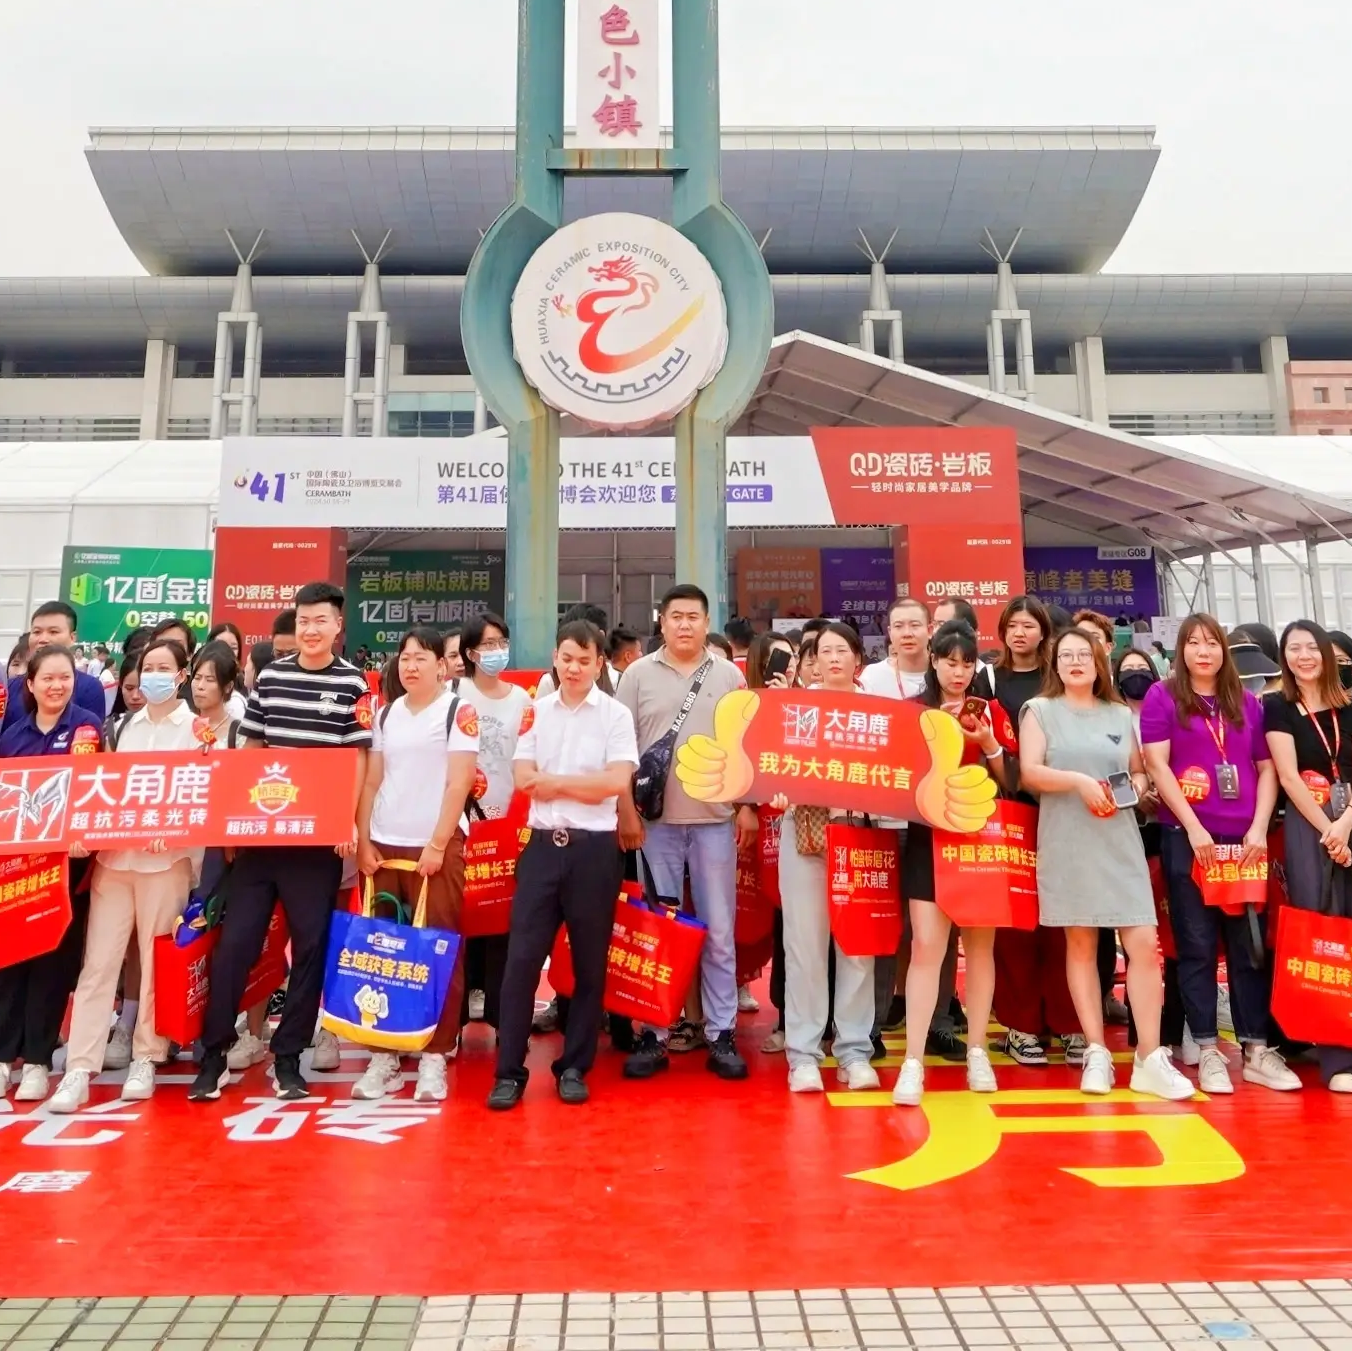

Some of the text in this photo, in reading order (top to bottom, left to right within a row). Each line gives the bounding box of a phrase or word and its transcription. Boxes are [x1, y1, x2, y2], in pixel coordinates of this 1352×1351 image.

[539, 241, 690, 345] HUAXIA CERAMIC EXPOSITION CITY
[569, 461, 606, 478] THE
[611, 459, 643, 478] 41st
[249, 472, 286, 503] 41
[305, 490, 351, 498] CERAMBATH
[732, 488, 764, 500] GATE
[871, 481, 973, 493] 轻时尚家居美学品牌
[1127, 548, 1146, 557] G08
[360, 570, 490, 593] 岩板铺贴就用
[825, 709, 889, 736] 大角鹿
[73, 743, 95, 754] 069
[759, 751, 913, 790] 我为大角鹿代言
[73, 762, 213, 807] 大角鹿
[1182, 784, 1204, 800] 071
[69, 808, 207, 831] 超抗污柔光砖
[226, 820, 315, 836] 超抗污 易清洁
[850, 848, 895, 869] 怕瓷砖磨花
[942, 844, 1037, 868] 中国瓷砖增长王
[853, 870, 889, 889] 用大角鹿
[337, 948, 430, 984] 全域获客系统
